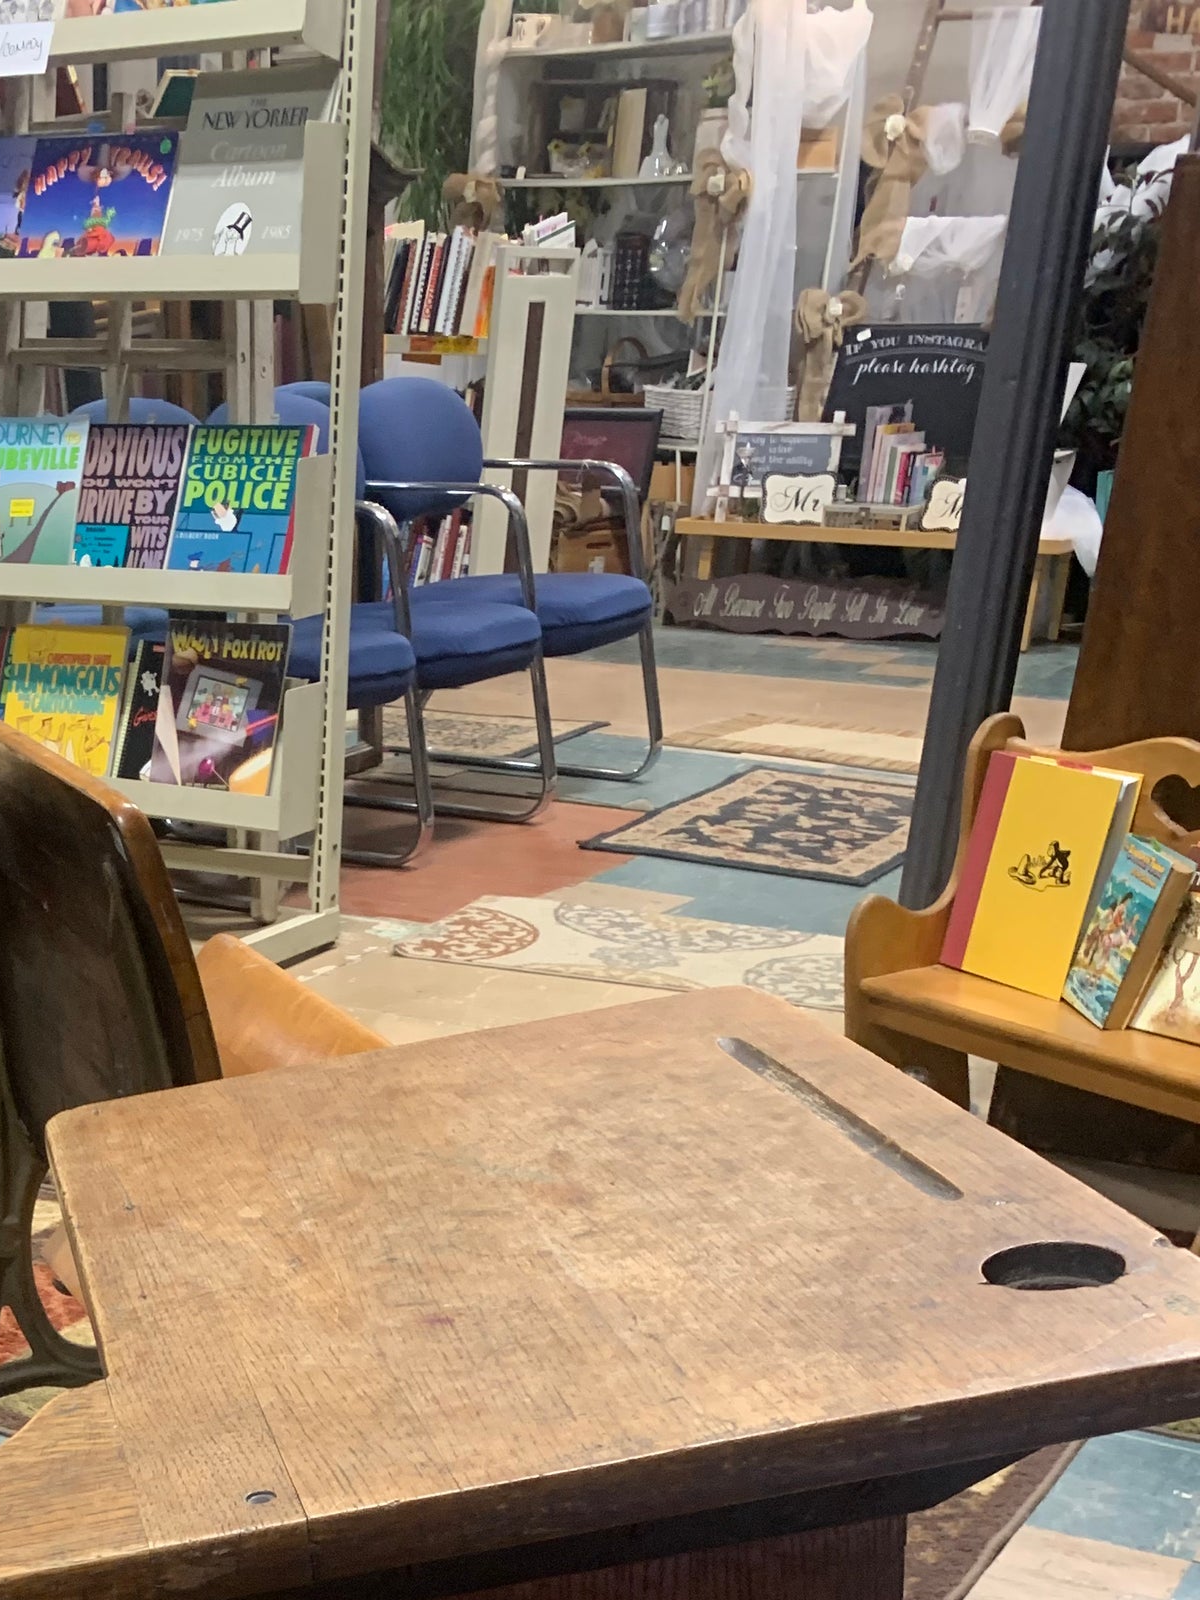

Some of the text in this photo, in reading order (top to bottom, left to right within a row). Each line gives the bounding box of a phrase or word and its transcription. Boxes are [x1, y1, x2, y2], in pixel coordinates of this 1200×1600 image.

[202, 107, 309, 131] NEW YORKER
[210, 141, 288, 162] Cartoon
[34, 146, 92, 196] HAPPY
[211, 165, 276, 188] Album
[870, 336, 900, 349] YOU
[907, 334, 985, 351] INSTAGRA
[852, 357, 977, 386] please hashtag
[83, 426, 185, 478] OBVIOUS
[193, 427, 300, 456] FUGITIVE
[187, 463, 294, 482] CUBICLE
[191, 456, 296, 466] FROM THE
[82, 479, 177, 488] OU WON'T
[183, 480, 290, 510] POLICE
[77, 489, 175, 524] URVIVE BY
[770, 484, 824, 513] Mr
[134, 515, 171, 525] YOUR
[130, 525, 169, 549] WITS
[126, 549, 165, 569] ALONE
[223, 638, 284, 662] FOXTROT
[8, 663, 122, 697] HUMONGOUS
